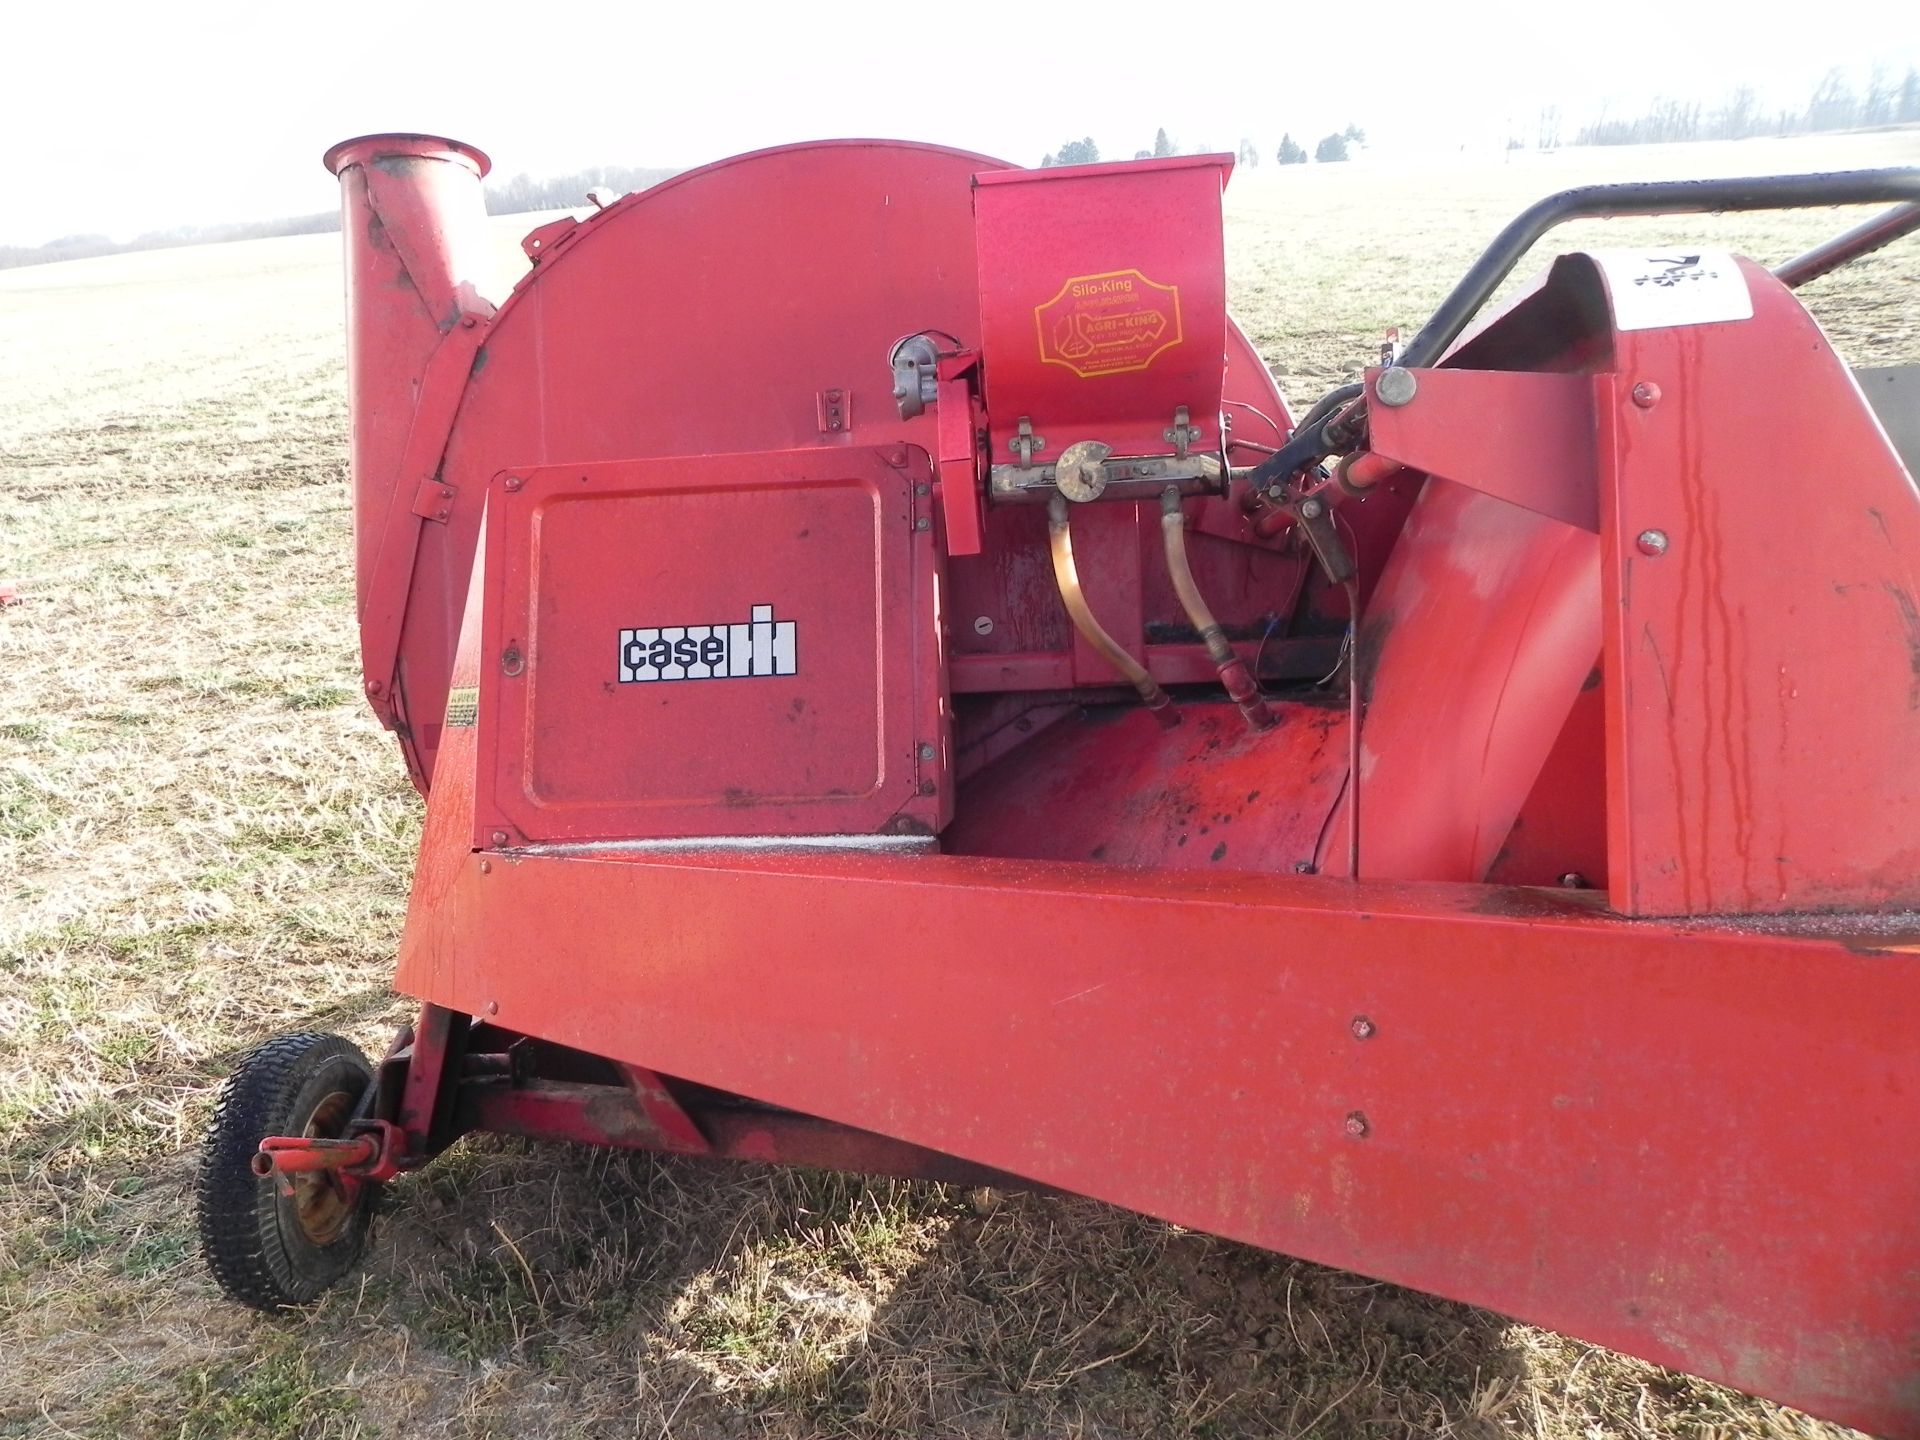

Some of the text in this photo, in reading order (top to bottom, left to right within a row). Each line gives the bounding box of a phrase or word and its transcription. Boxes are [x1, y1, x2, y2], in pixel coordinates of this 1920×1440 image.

[1072, 280, 1132, 297] Silo-King
[1086, 314, 1158, 334] AGRI-KING
[622, 634, 726, 674] case
